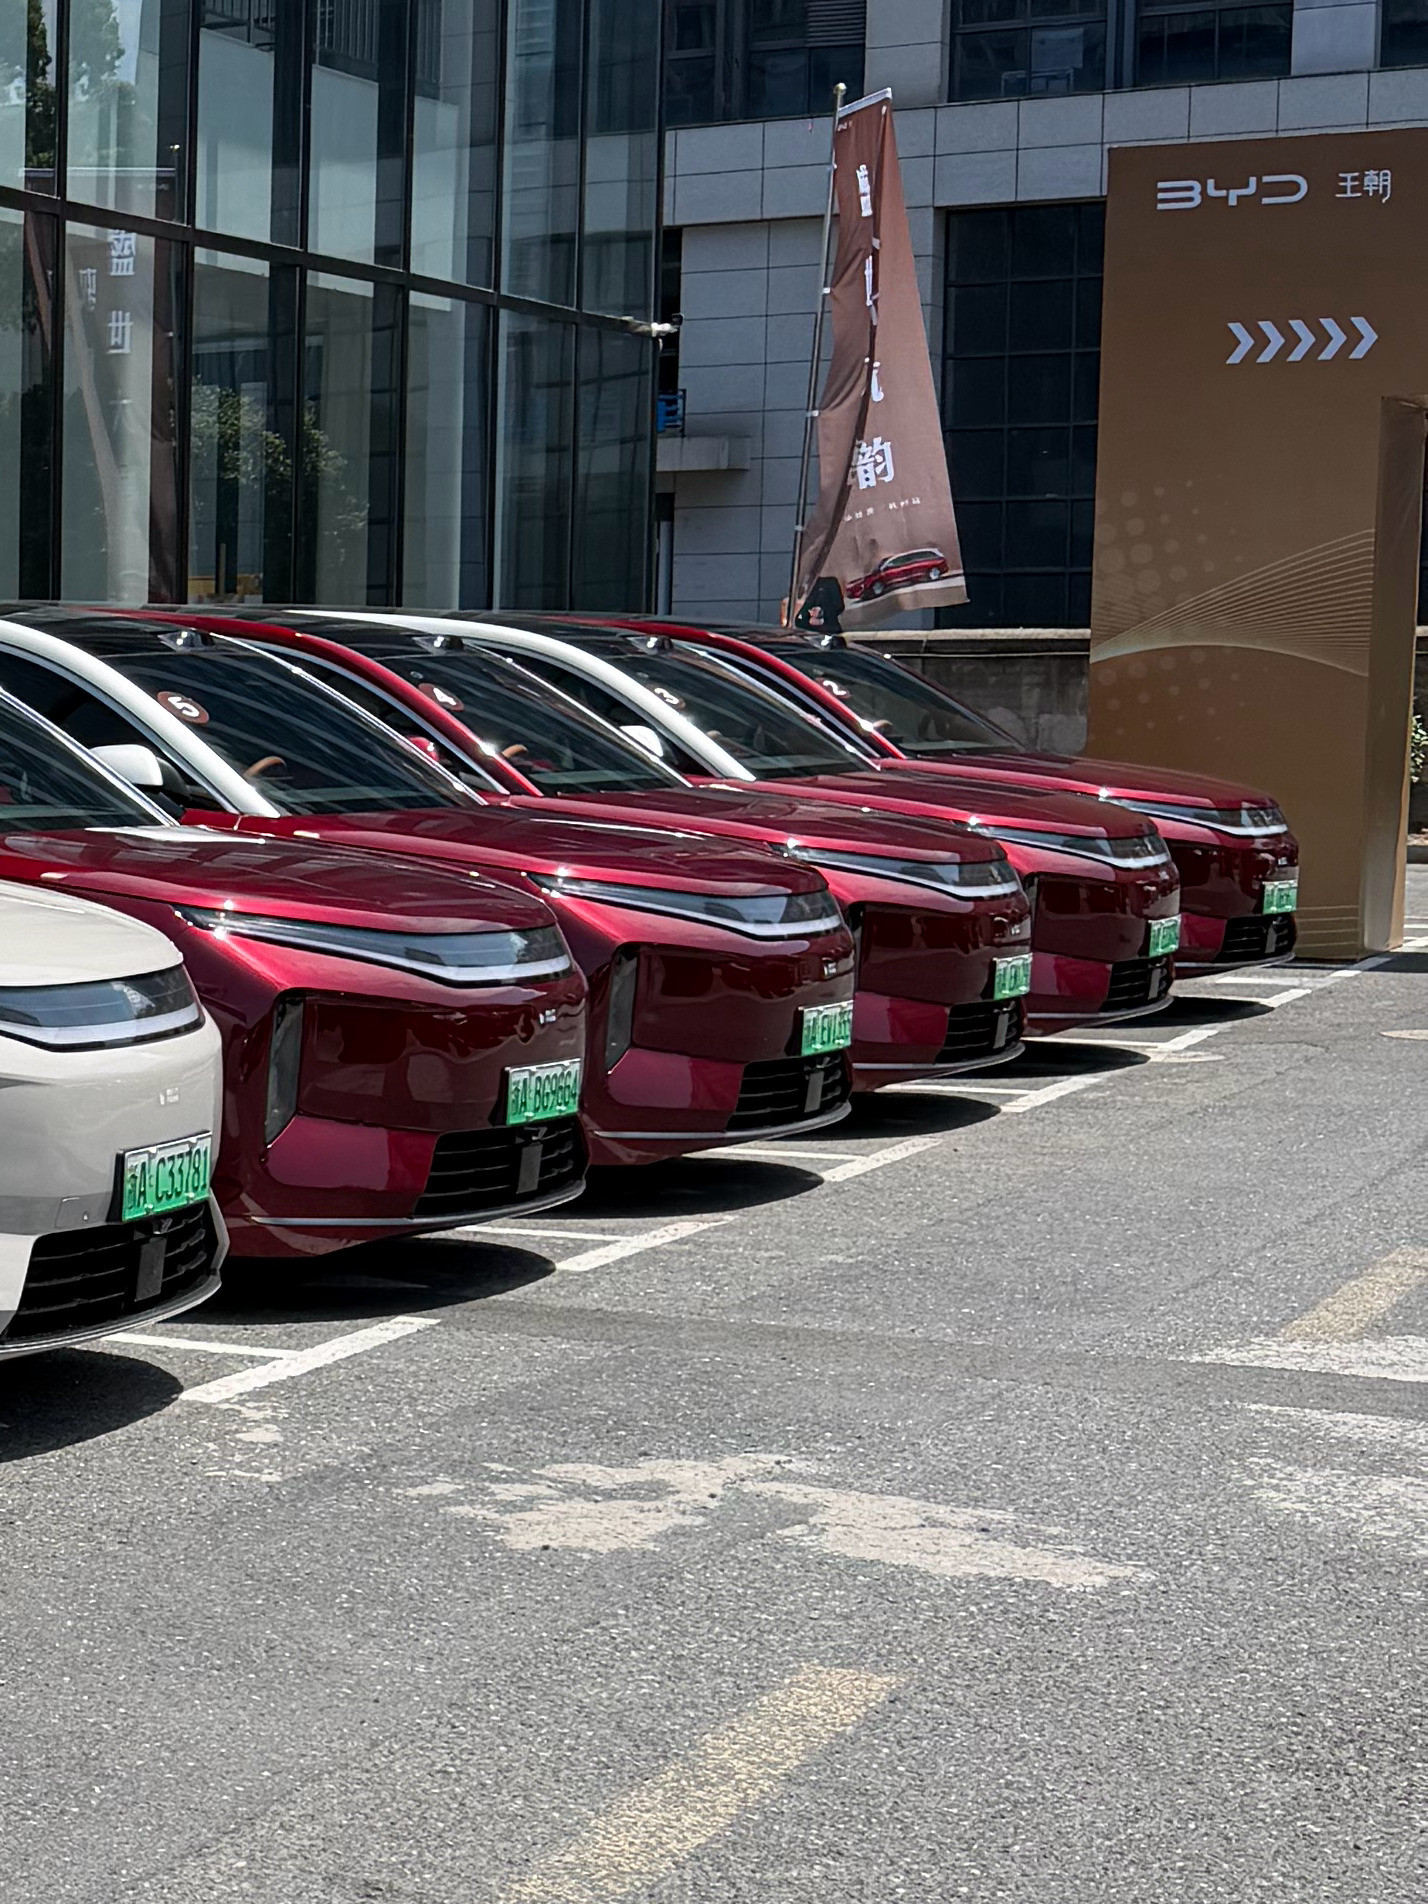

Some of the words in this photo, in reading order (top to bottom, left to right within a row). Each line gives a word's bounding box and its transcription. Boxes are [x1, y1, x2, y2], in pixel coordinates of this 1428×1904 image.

[1156, 174, 1309, 212] BYD
[1335, 169, 1393, 204] 王朝
[167, 696, 200, 718] 5
